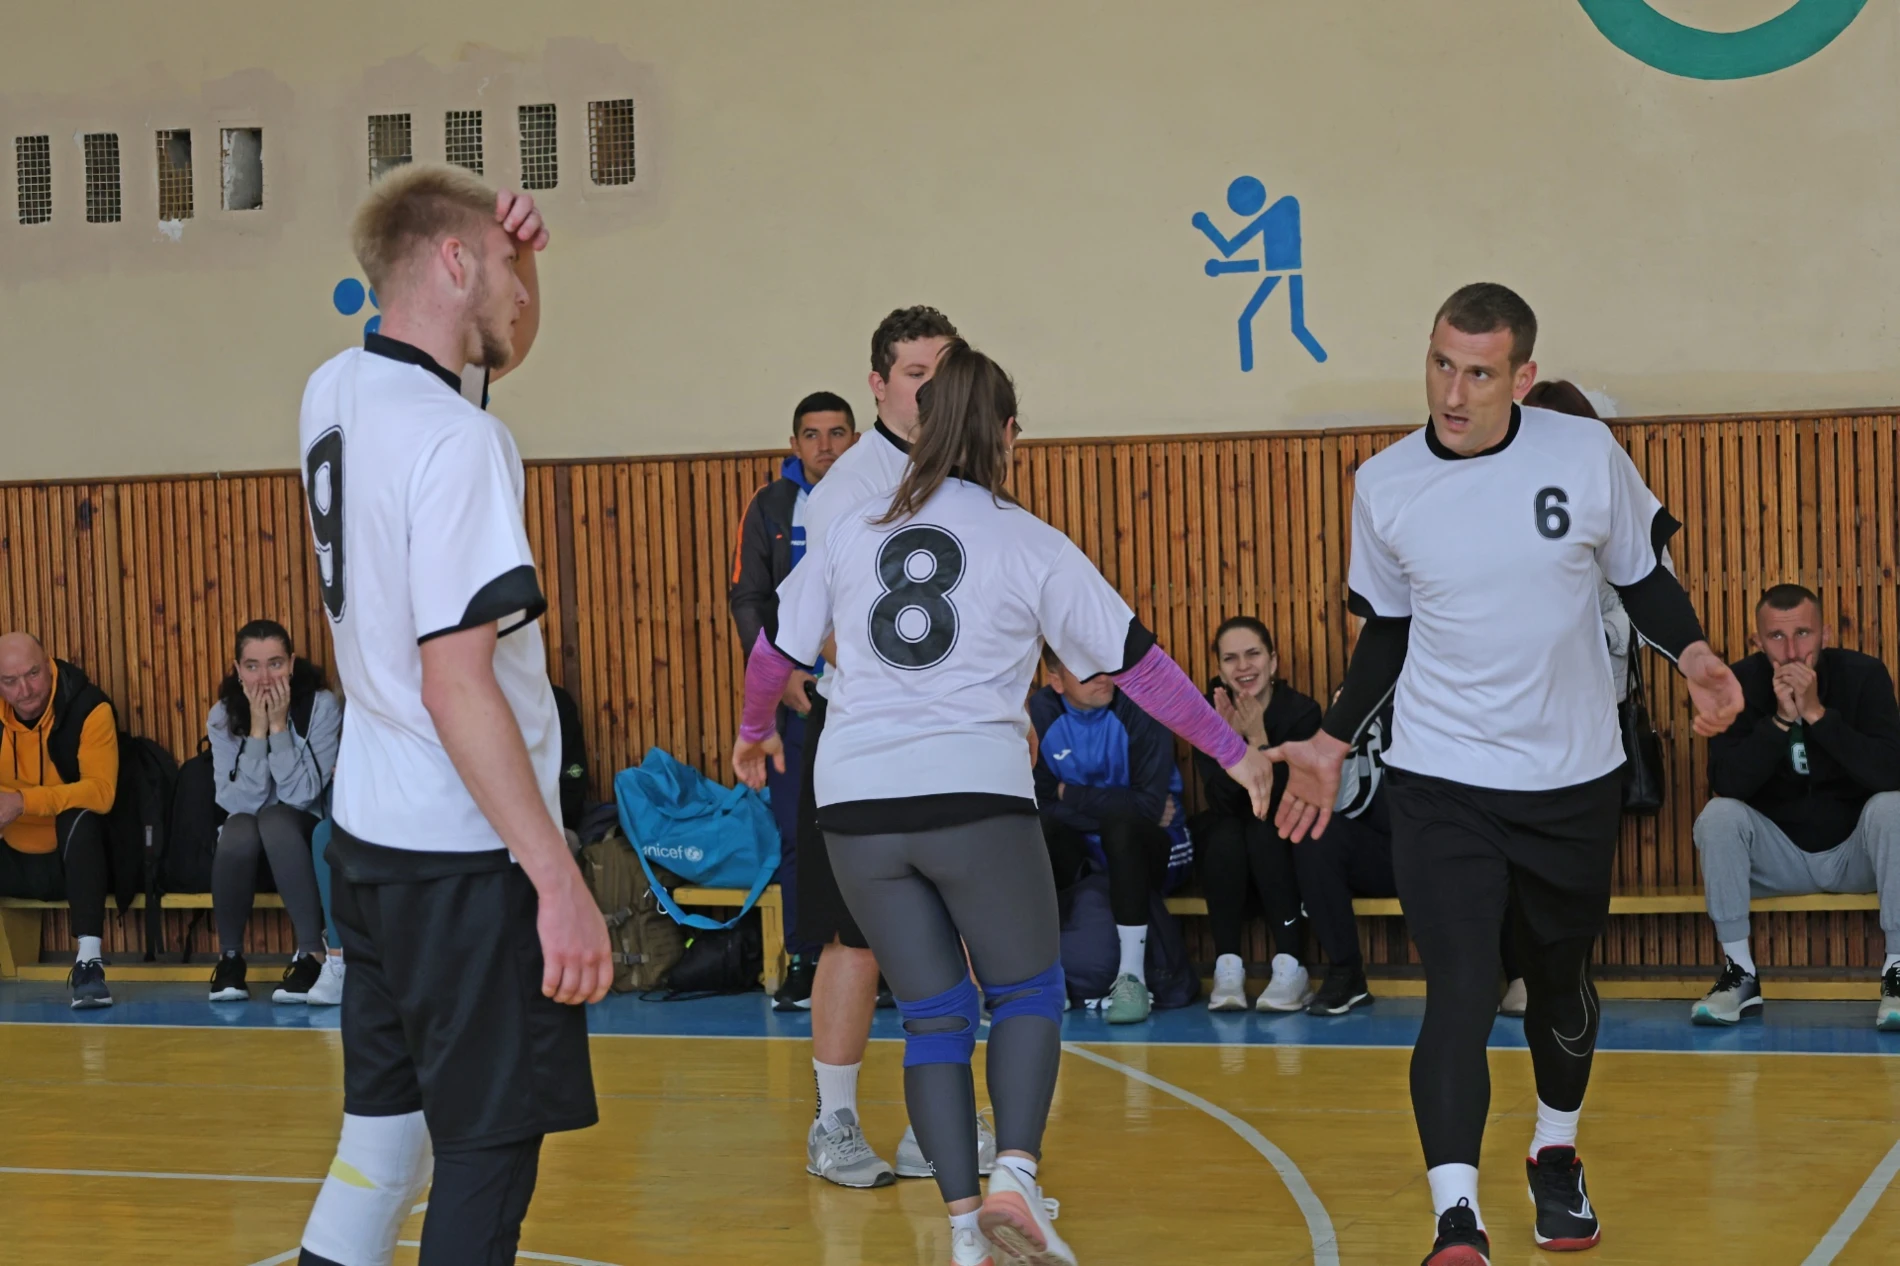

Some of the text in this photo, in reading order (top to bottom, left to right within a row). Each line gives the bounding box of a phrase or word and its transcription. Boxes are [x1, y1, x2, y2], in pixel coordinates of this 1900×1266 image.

[306, 424, 346, 623] 9
[1533, 485, 1572, 541] 6
[867, 523, 967, 671] 8
